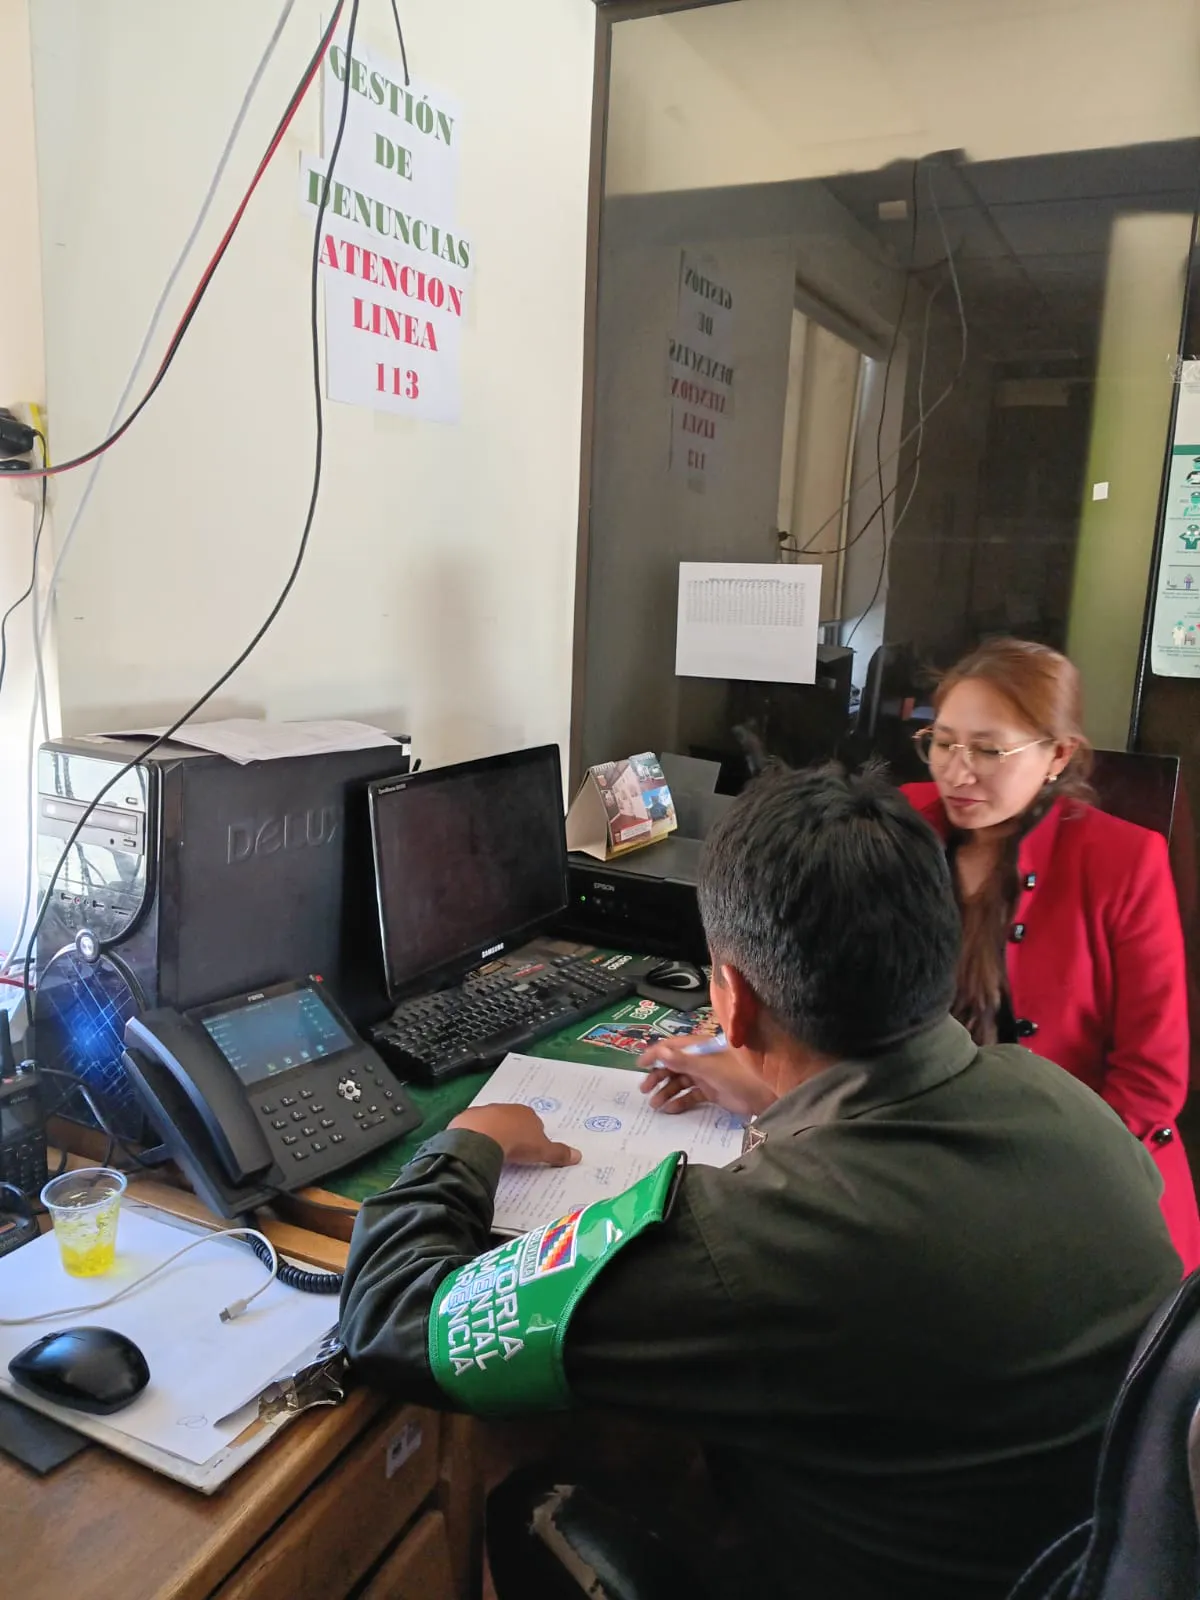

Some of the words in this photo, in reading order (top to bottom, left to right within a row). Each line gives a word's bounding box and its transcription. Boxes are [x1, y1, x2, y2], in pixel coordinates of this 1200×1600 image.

[329, 44, 454, 146] GESTIÓN
[374, 132, 413, 182] DE
[306, 168, 470, 269] DENUNCIAS
[318, 234, 463, 317] ATENCION
[352, 297, 438, 352] LINEA
[375, 362, 419, 400] 113
